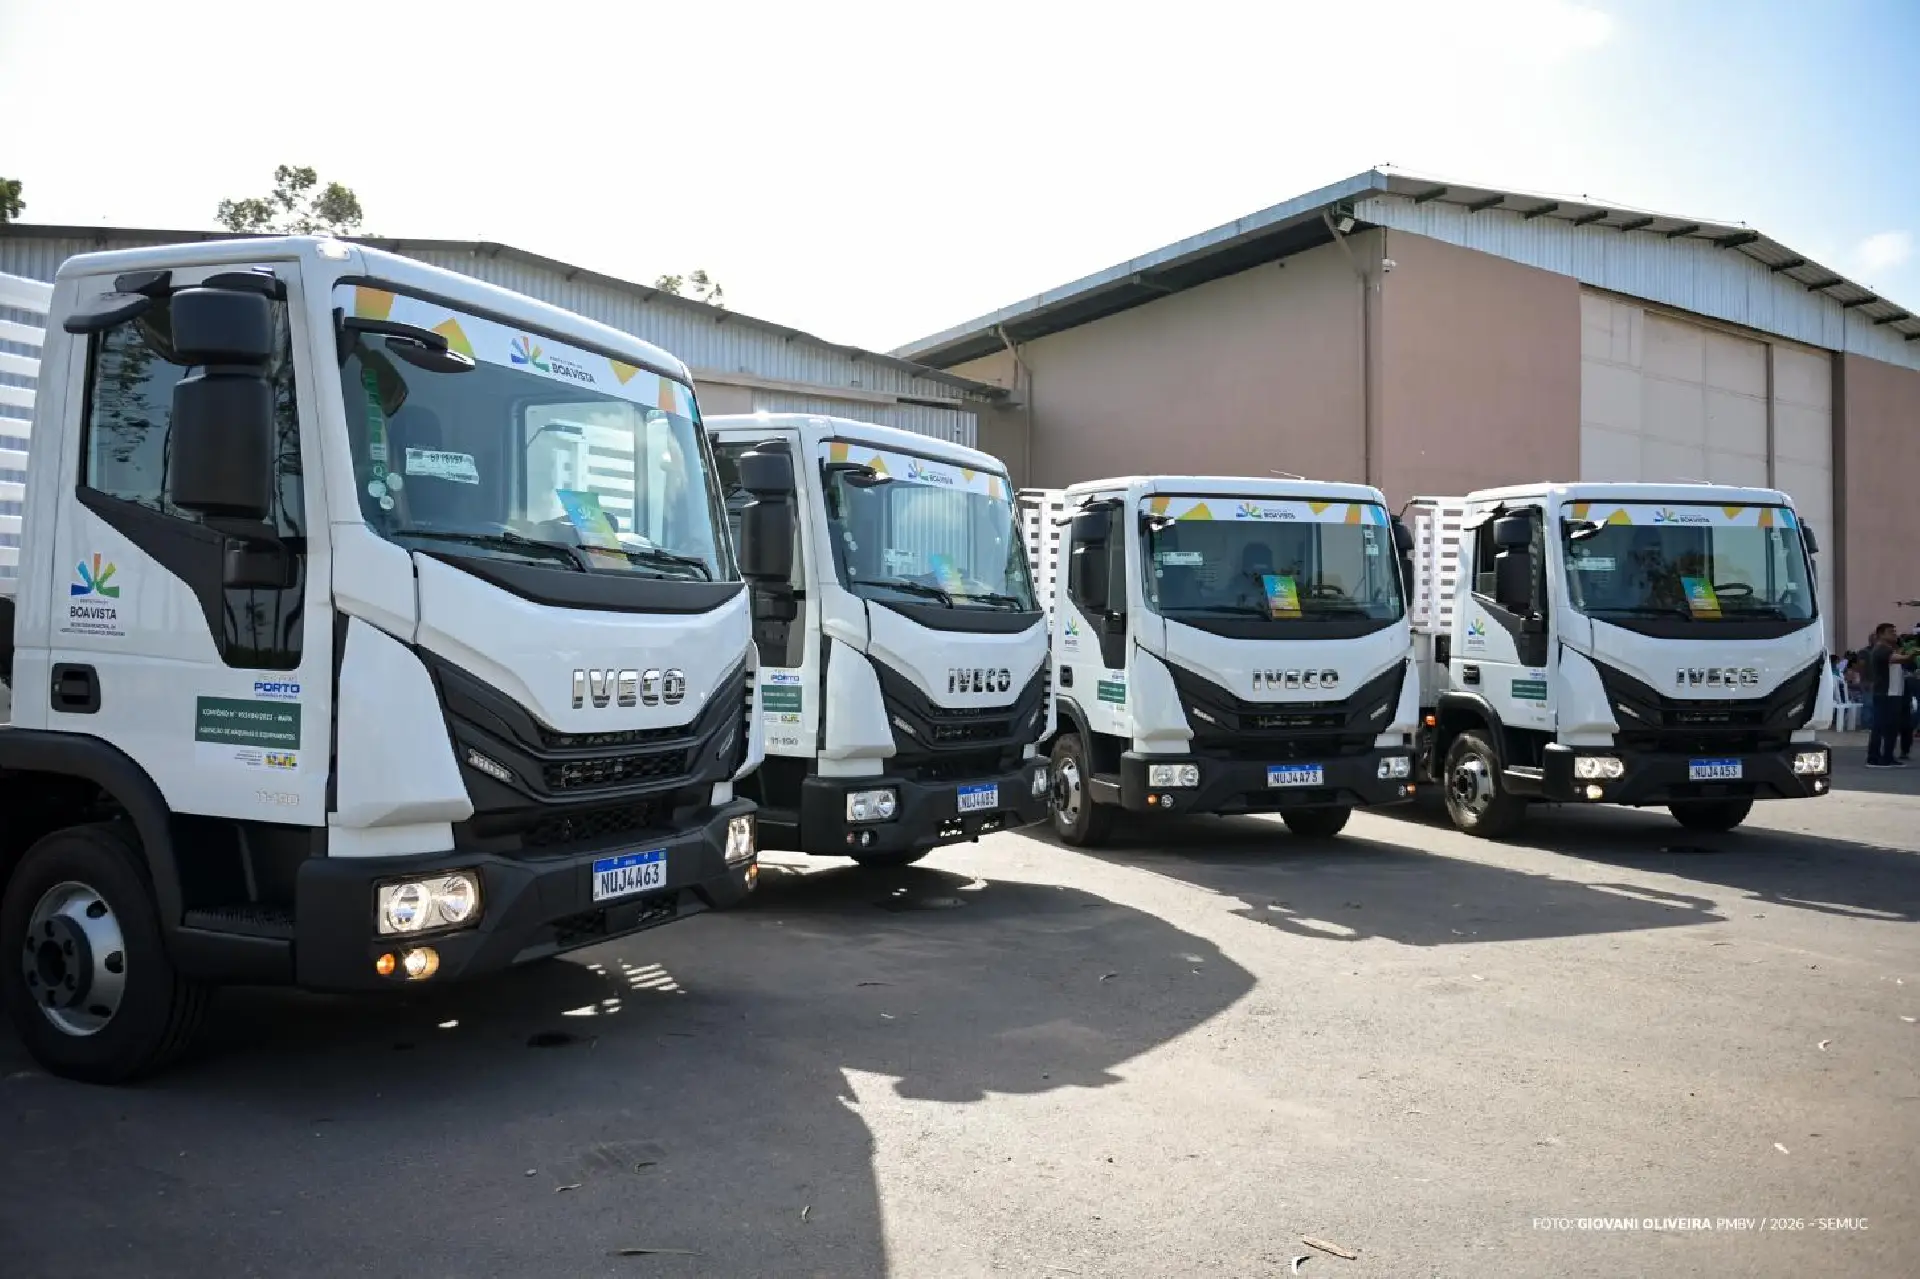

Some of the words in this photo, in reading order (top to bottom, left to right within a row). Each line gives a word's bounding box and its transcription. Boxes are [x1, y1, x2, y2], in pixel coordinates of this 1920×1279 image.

[254, 682, 300, 694] PORTO
[572, 668, 686, 709] IVECO
[948, 668, 1011, 693] IVECO
[1252, 669, 1339, 691] IVECO
[1676, 668, 1759, 688] IVECO
[601, 863, 660, 896] NUJ4A63
